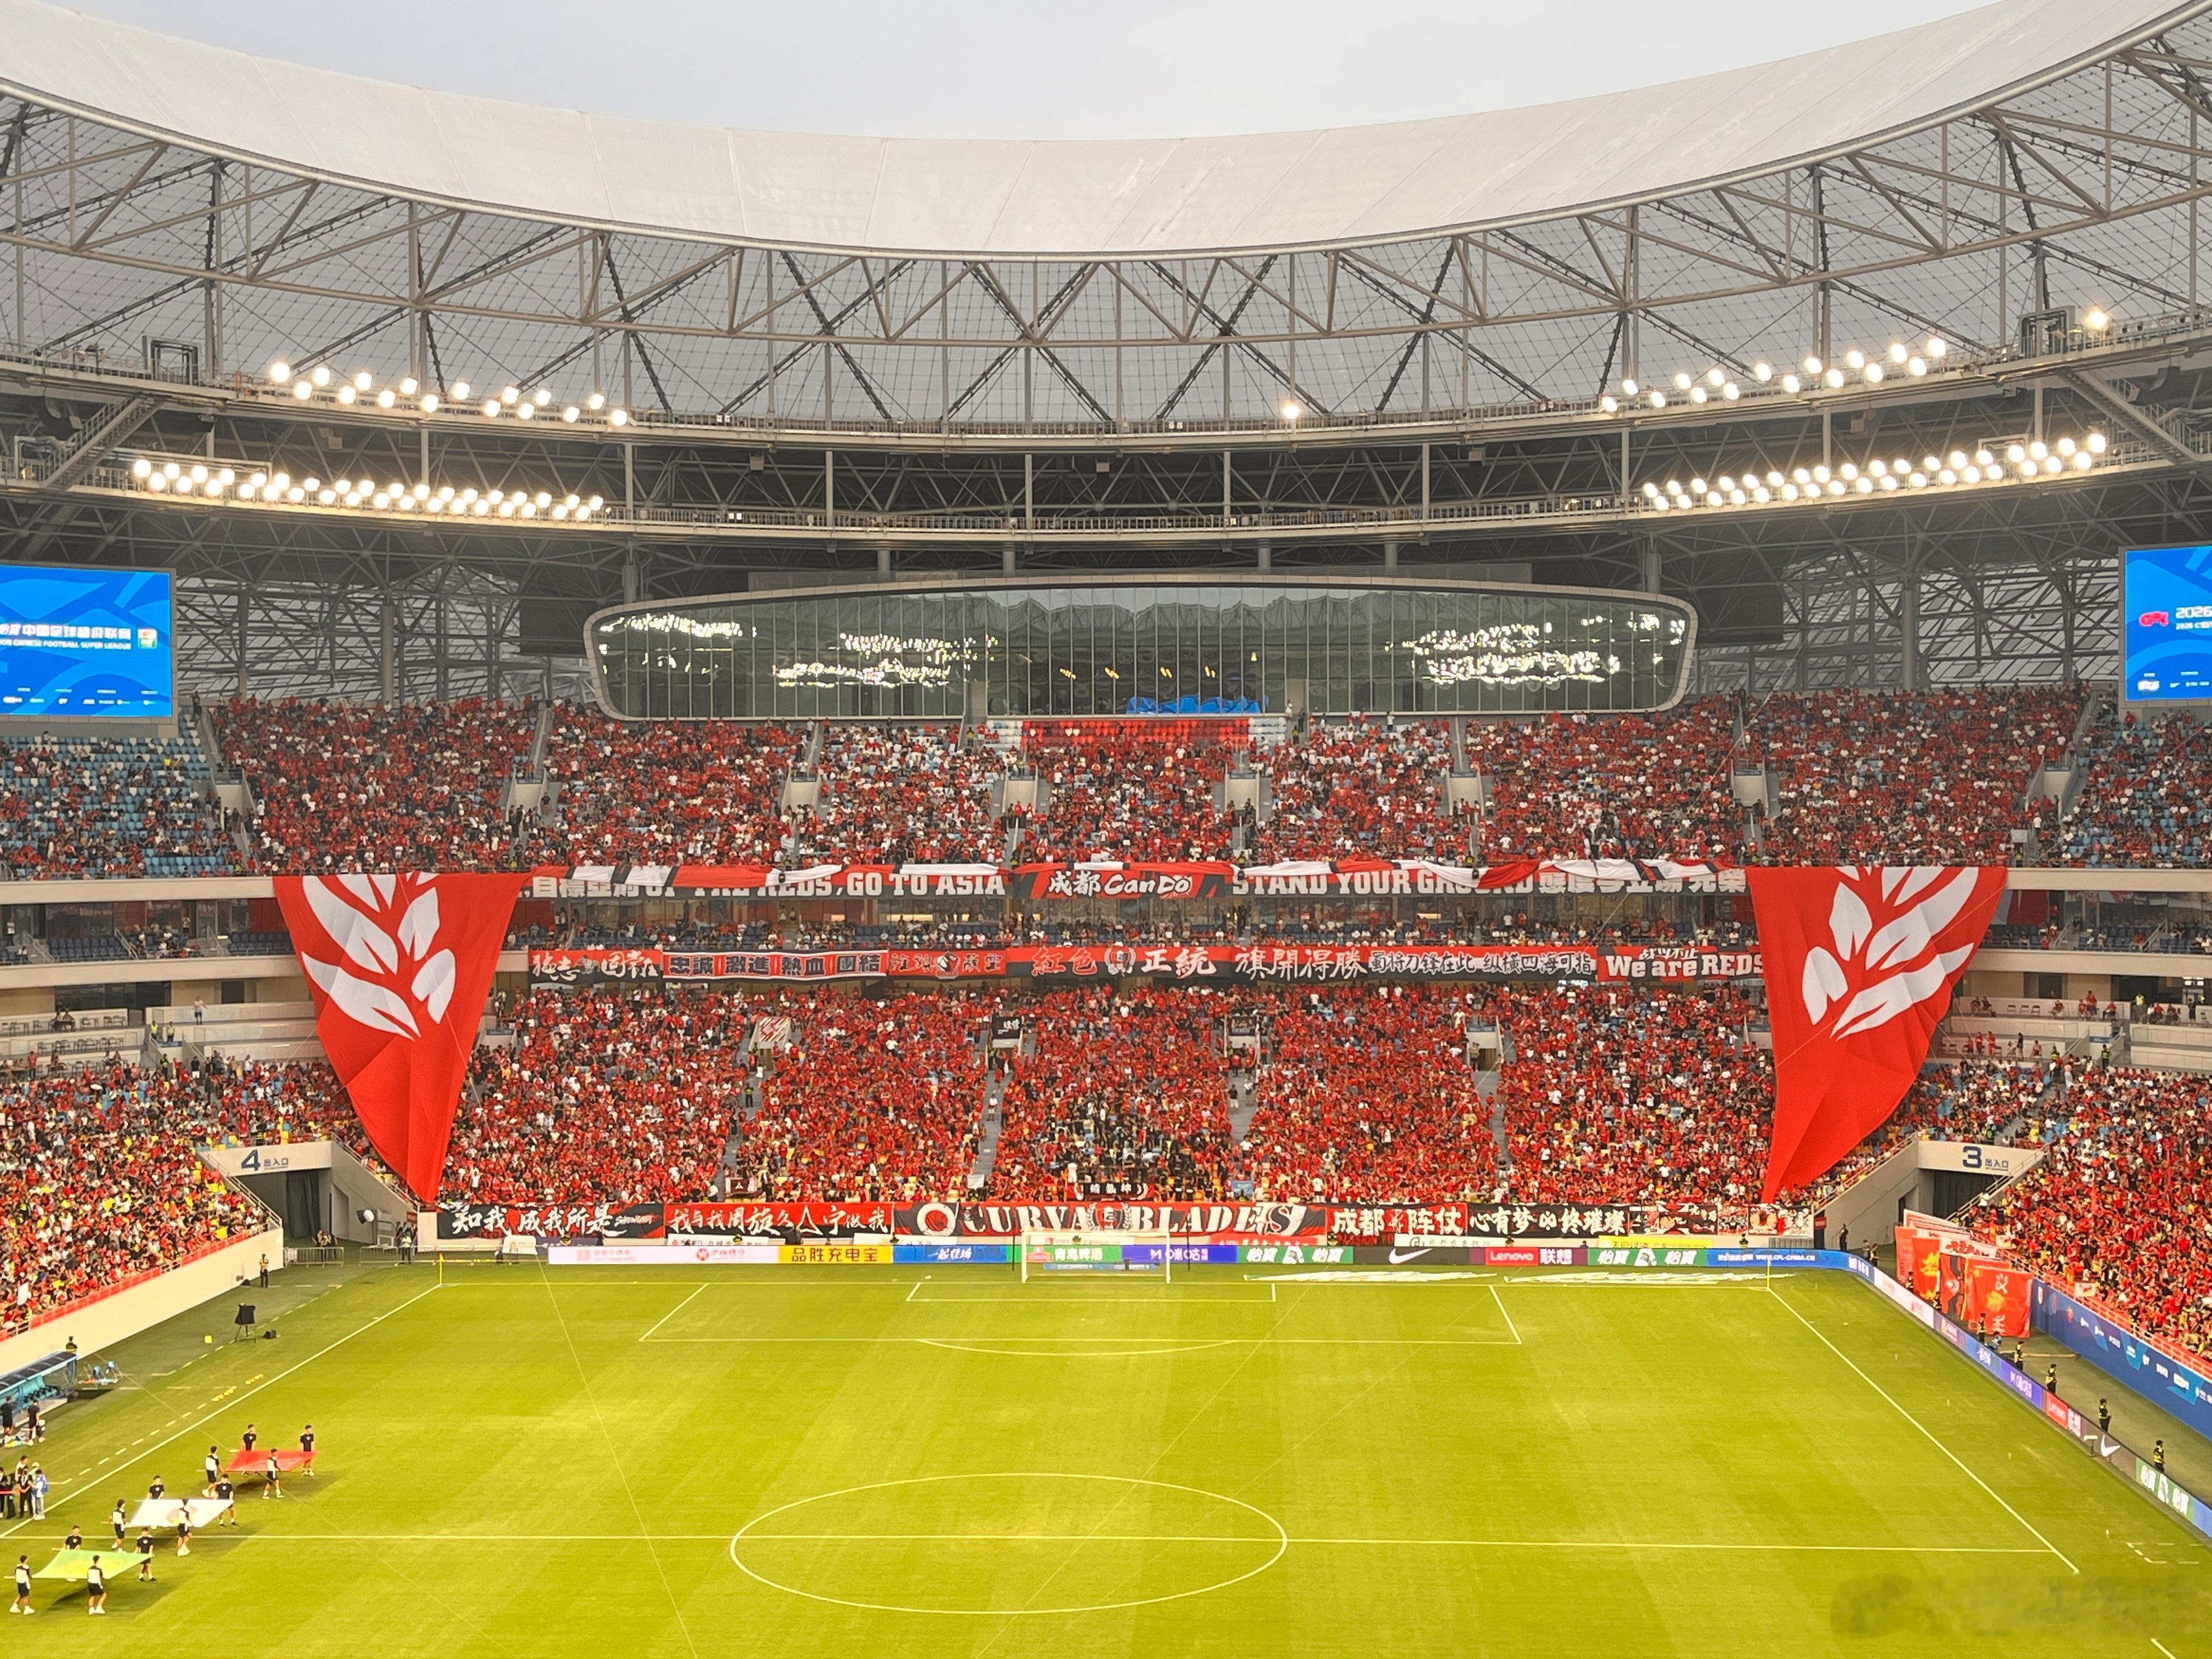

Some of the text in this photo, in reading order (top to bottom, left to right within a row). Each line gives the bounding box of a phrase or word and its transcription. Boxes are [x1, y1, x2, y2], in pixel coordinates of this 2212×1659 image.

[2176, 606, 2212, 619] 2026
[847, 873, 882, 896] GO
[889, 873, 927, 896] TO
[935, 874, 1006, 896] ASIA
[1048, 870, 1101, 898] 成都
[1233, 869, 1533, 895] STAND YOUR GRD
[1031, 947, 1217, 979] 紅色 正統
[1235, 946, 1368, 981] 旗開得勝
[1370, 951, 1476, 975] 蜀将刀锋在此
[1606, 954, 1763, 978] We are REDS
[241, 1149, 261, 1172] 4
[1962, 1146, 1982, 1169] 3
[963, 1203, 1294, 1234] CURVA BLADES
[1331, 1206, 1465, 1236] 成都 阵仗
[1470, 1206, 1626, 1235] 心有梦 终璀璨
[792, 1247, 878, 1262] 品胜充电宝
[1490, 1250, 1534, 1262] Lenovo
[1540, 1248, 1573, 1265] 联想
